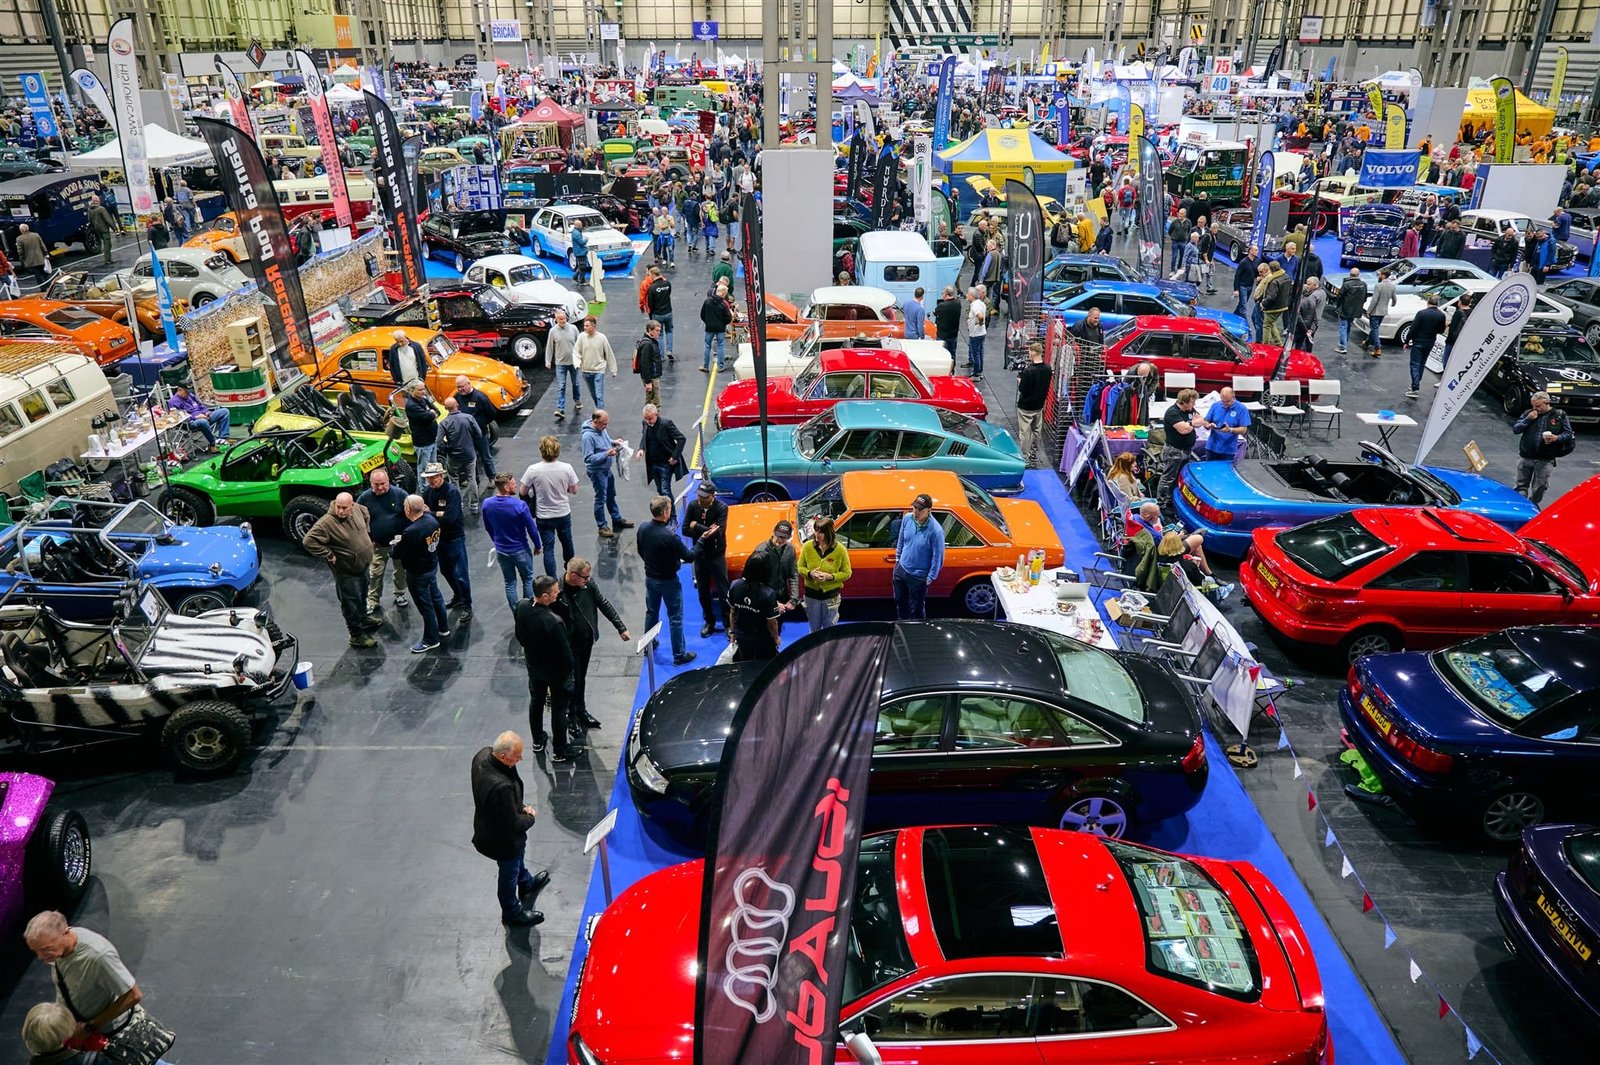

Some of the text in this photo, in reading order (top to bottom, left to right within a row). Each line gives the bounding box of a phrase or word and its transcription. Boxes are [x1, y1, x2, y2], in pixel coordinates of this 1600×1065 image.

[493, 25, 516, 39] ERICAN
[1215, 59, 1230, 73] 75
[1212, 77, 1227, 91] 40
[1365, 164, 1415, 175] VOLVO
[60, 180, 78, 200] WOOD
[83, 180, 100, 191] SONS
[877, 165, 892, 227] NORDIK
[787, 776, 851, 1065] ubAudi
